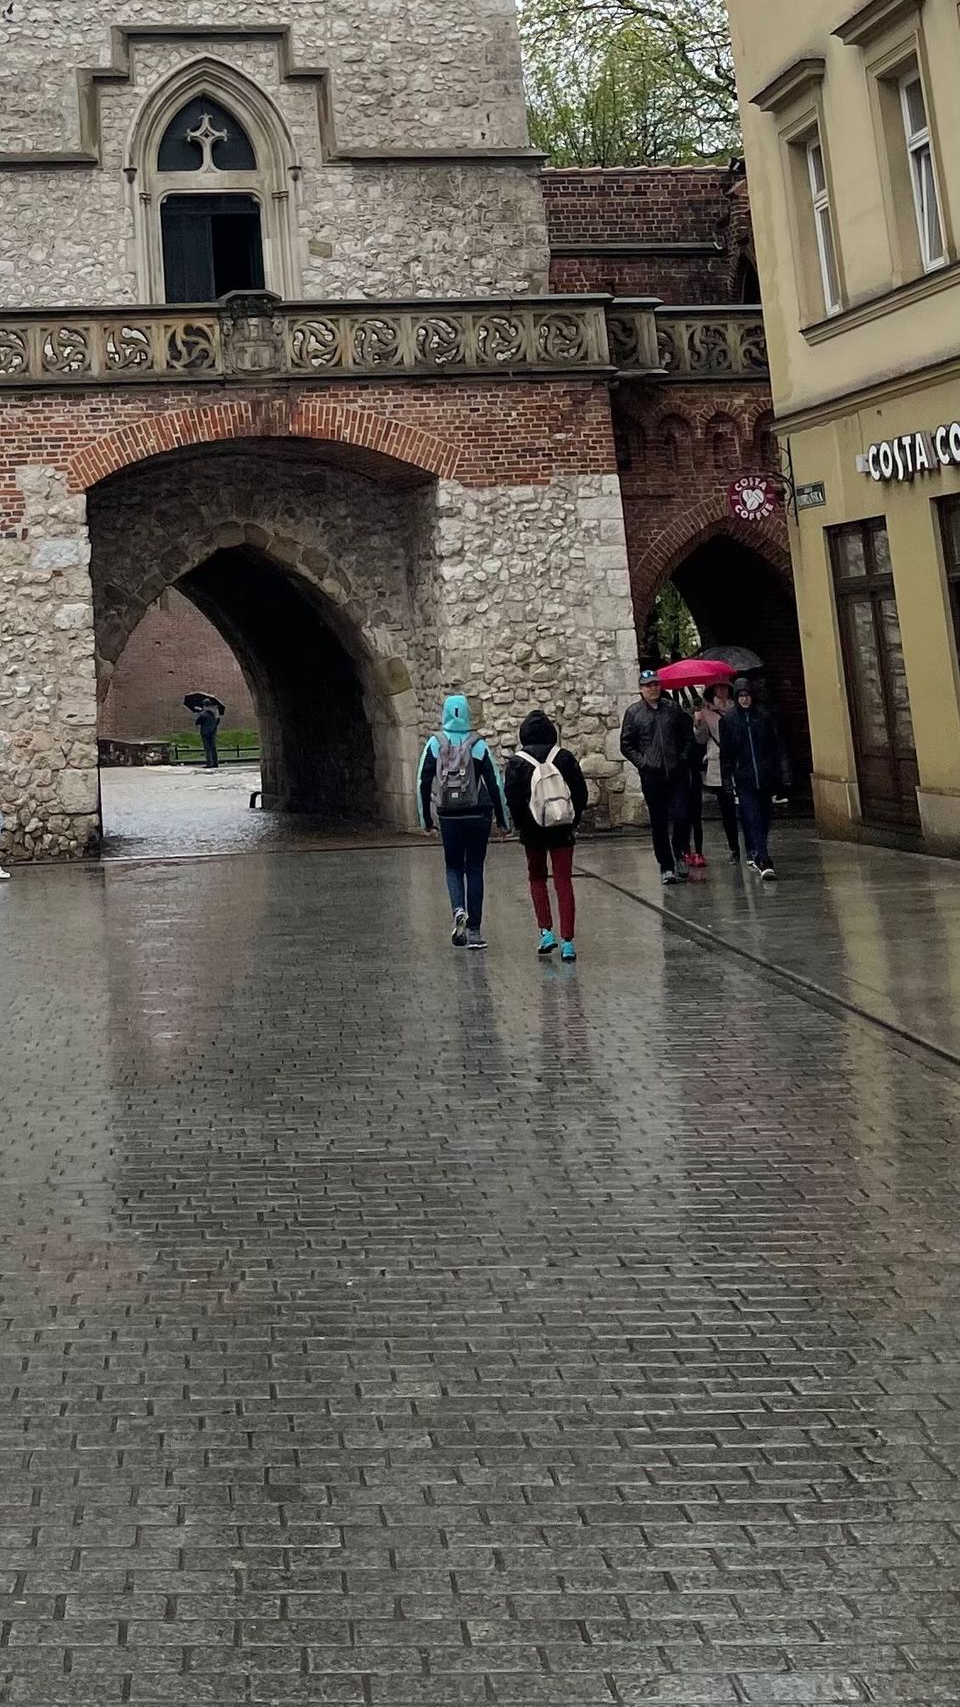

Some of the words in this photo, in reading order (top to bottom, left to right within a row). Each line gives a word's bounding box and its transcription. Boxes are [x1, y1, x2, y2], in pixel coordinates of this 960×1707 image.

[868, 432, 929, 481] COSTA
[734, 477, 767, 492] COSTA
[734, 504, 774, 521] COFFEE
